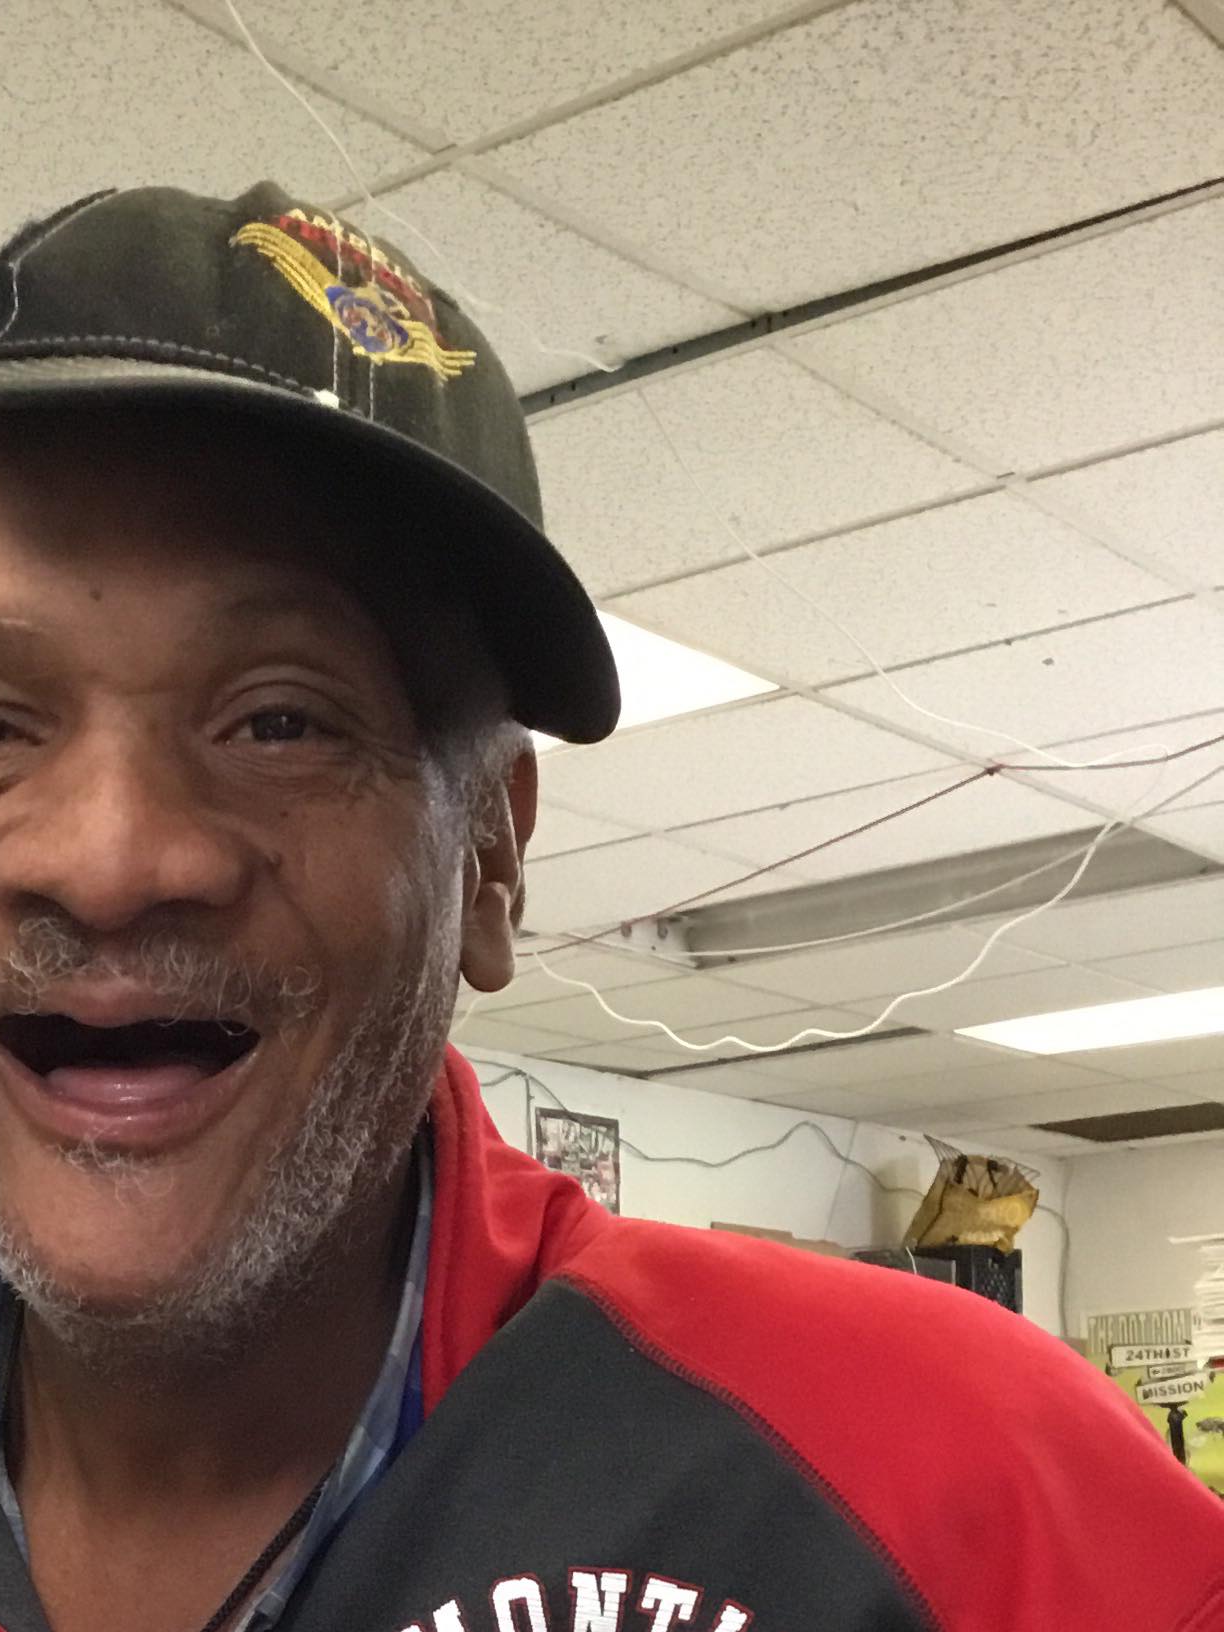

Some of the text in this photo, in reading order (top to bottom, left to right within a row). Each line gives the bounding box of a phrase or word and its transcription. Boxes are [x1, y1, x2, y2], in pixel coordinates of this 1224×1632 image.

[1126, 1347, 1190, 1361] 24TH ST
[1142, 1380, 1205, 1400] MISSION
